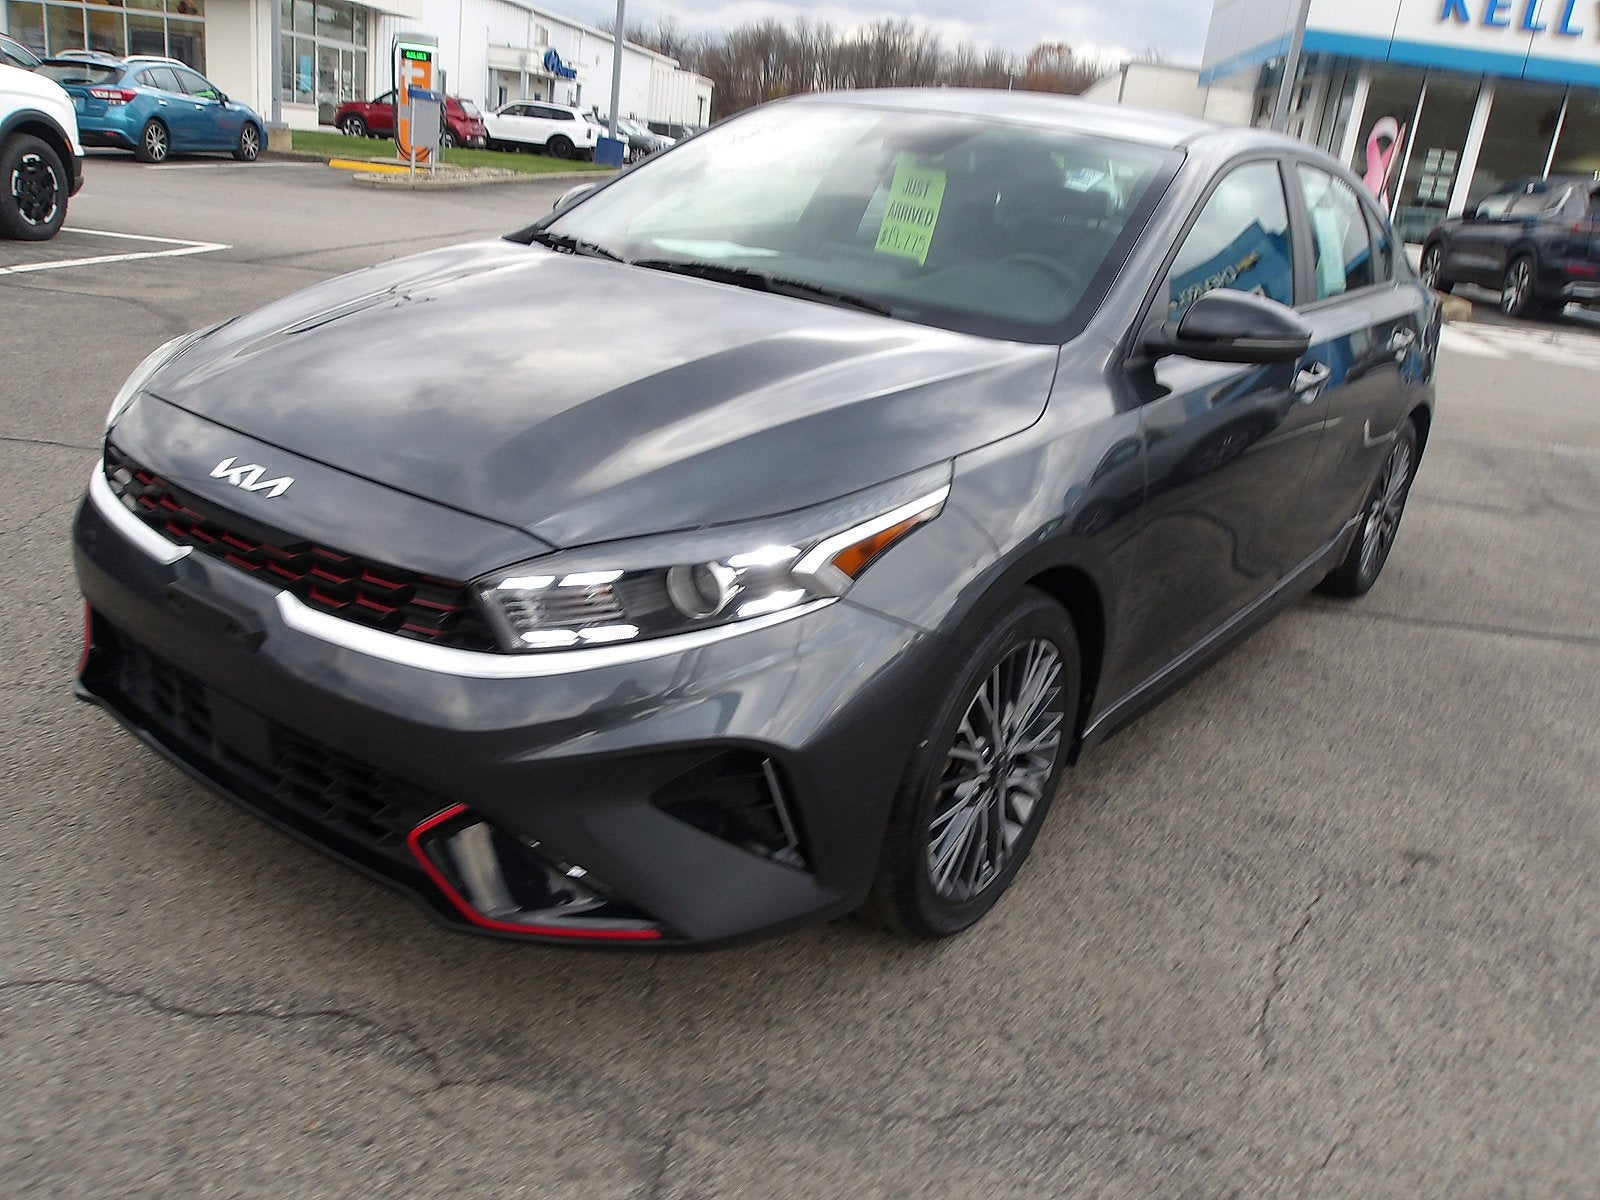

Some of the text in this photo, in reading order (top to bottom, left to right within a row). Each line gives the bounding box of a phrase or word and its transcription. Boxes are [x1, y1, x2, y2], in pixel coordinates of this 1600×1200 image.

[902, 177, 930, 199] JUST
[887, 201, 935, 227] ARRIVED
[209, 456, 296, 499] KIA
